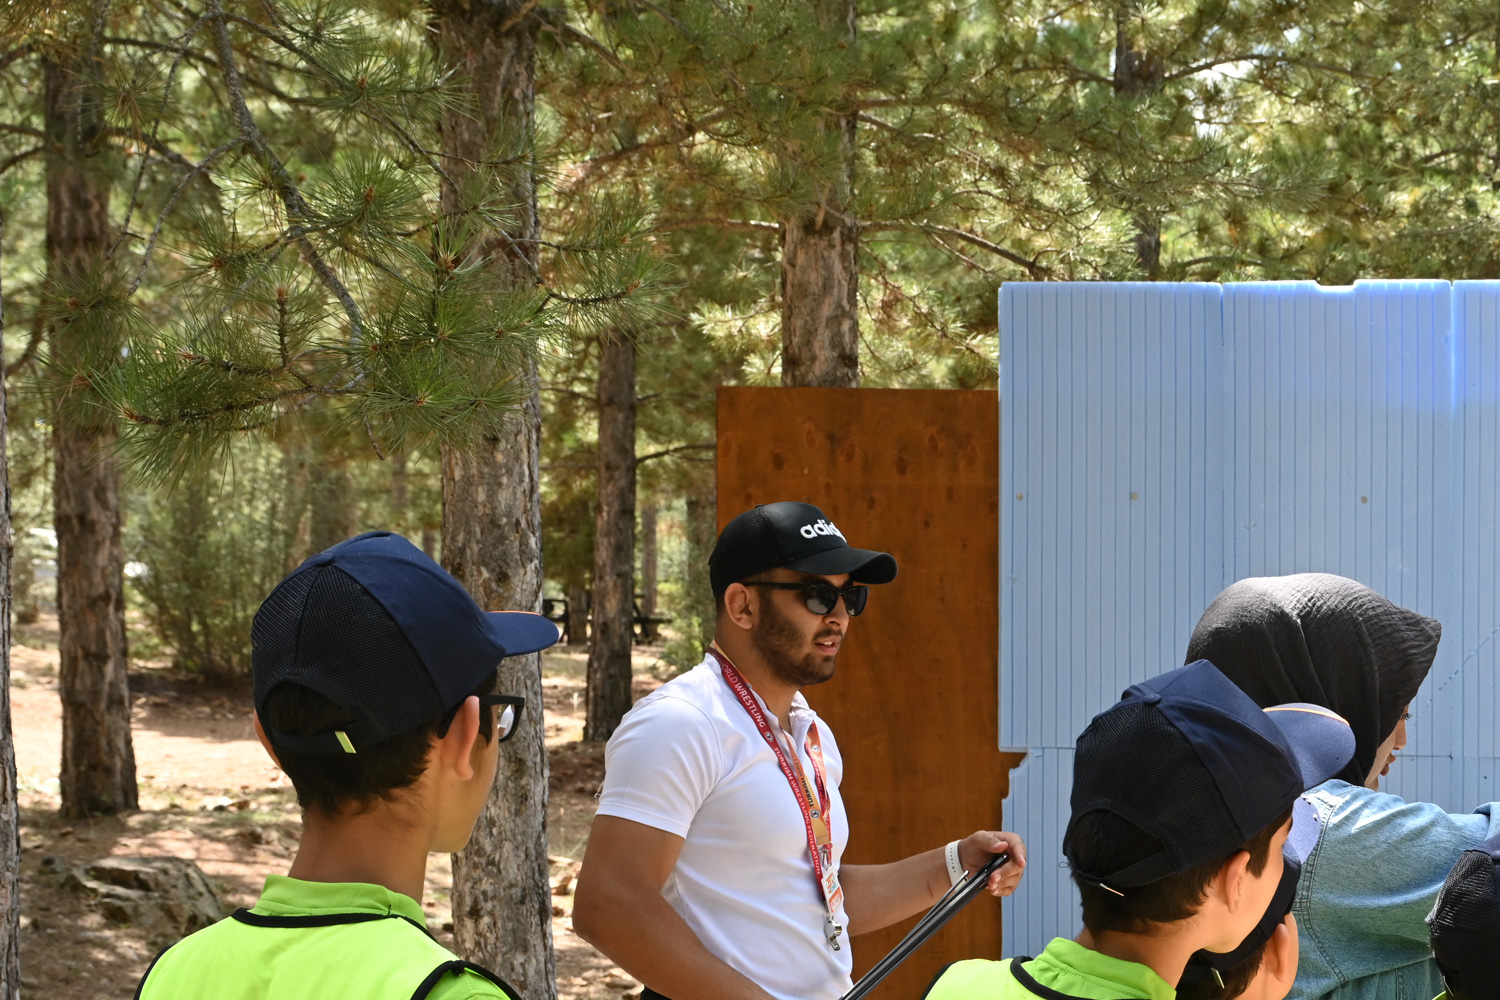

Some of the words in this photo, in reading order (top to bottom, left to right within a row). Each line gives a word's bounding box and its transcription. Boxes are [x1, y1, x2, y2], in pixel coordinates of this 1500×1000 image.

[735, 683, 766, 728] WRESTLING
[774, 747, 793, 780] TURKISH
[791, 780, 811, 824] WRESTLING
[806, 825, 821, 875] FEDERATION
